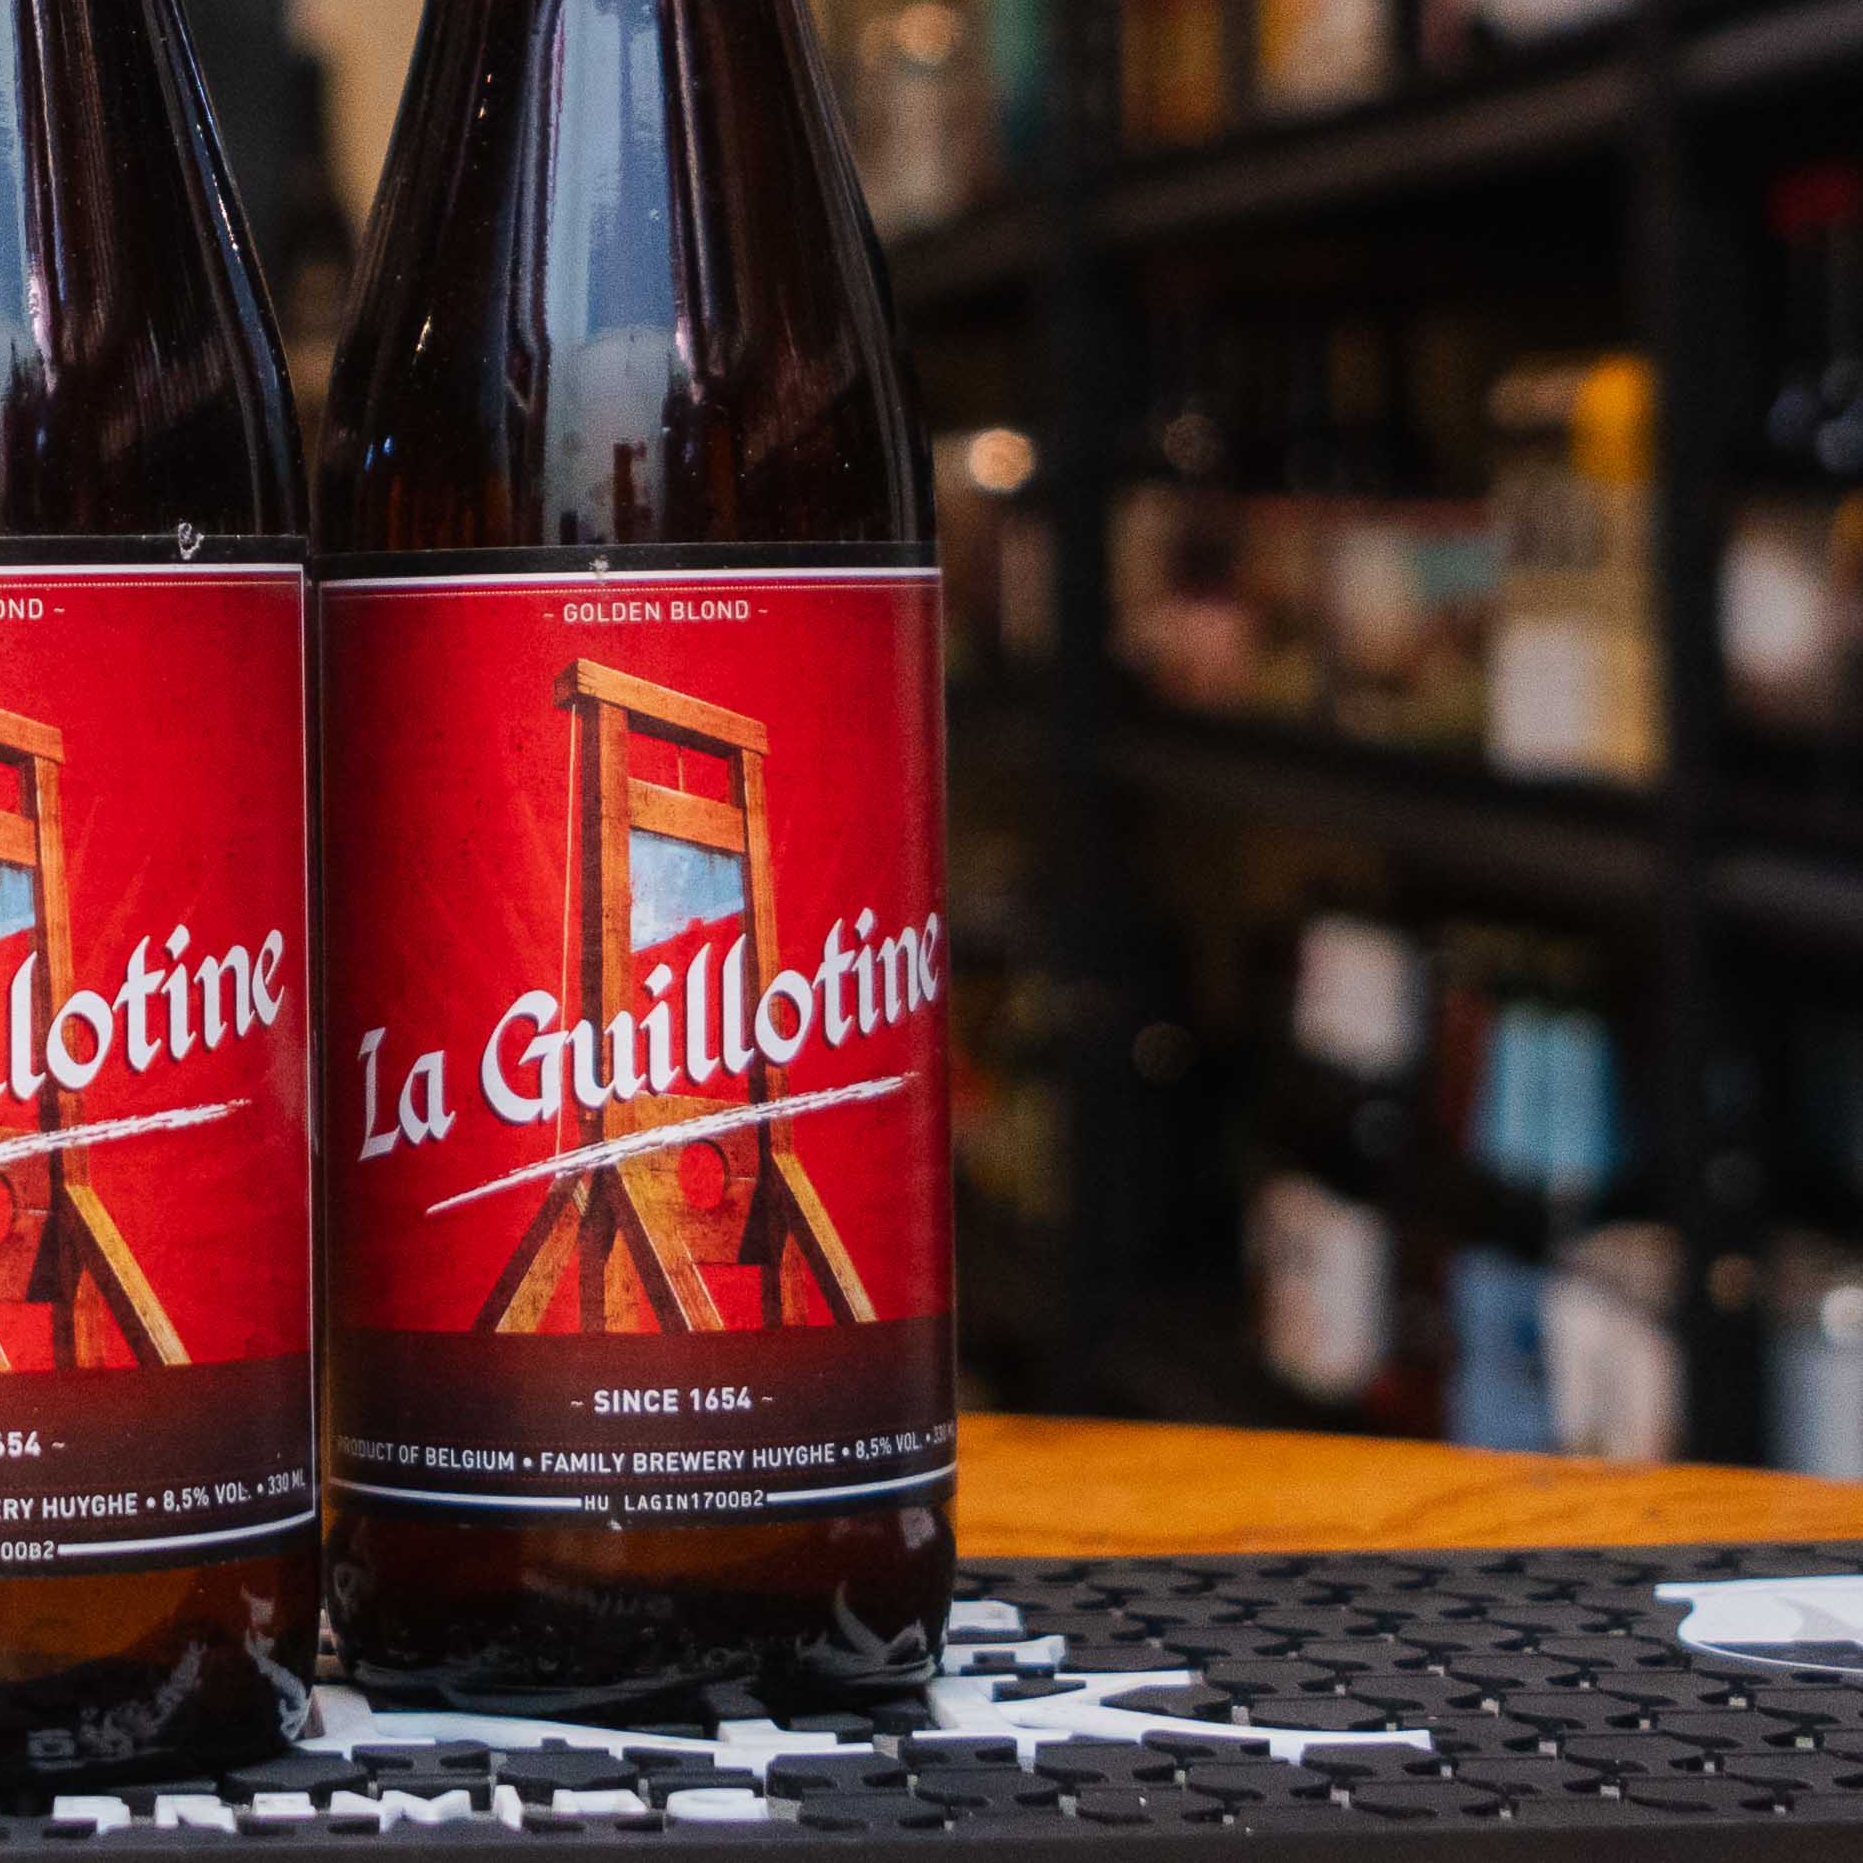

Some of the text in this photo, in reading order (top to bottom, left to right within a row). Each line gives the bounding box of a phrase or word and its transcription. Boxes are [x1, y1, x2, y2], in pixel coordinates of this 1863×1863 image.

[563, 599, 750, 624] GOLDEN BLOND
[357, 906, 940, 1162] La Guillotine
[594, 1386, 753, 1415] SINCE 1654
[398, 1444, 420, 1465] OF
[425, 1446, 515, 1471] BELGIUM
[541, 1451, 625, 1473] FAMILY
[634, 1448, 746, 1473] BREWERY
[753, 1442, 835, 1469] HUYGHE
[42, 1491, 138, 1519] HUYGHE
[214, 1480, 252, 1505] VOL.
[268, 1473, 289, 1495] 330
[291, 1468, 306, 1489] ML
[584, 1494, 610, 1512] HU
